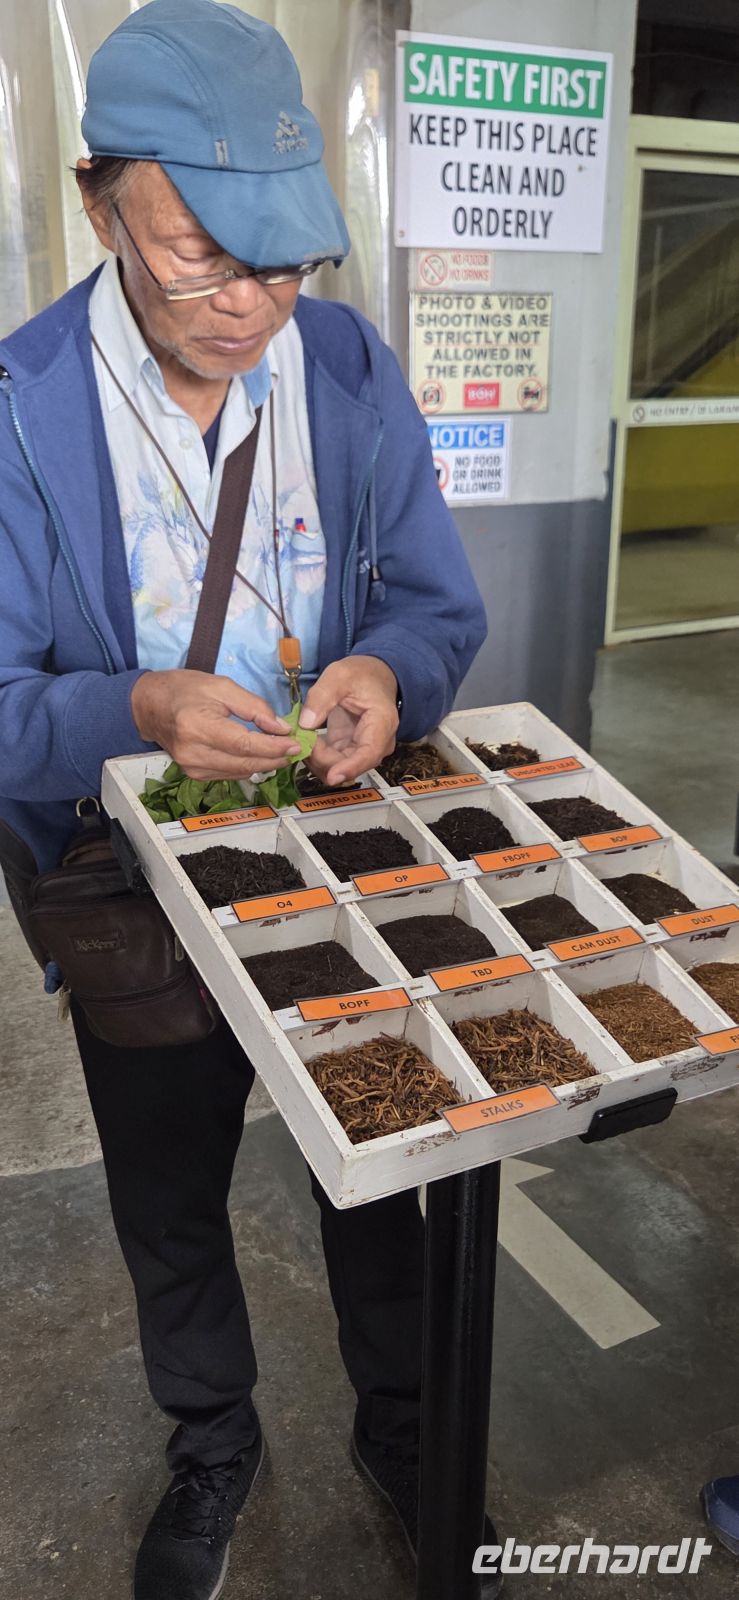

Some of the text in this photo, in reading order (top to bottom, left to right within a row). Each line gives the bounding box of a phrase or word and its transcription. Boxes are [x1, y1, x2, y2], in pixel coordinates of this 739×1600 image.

[408, 51, 604, 111] SAFETY FIRST
[408, 114, 598, 157] KEEP THIS PLACE
[440, 161, 565, 197] CLEAN AND
[452, 206, 553, 239] ORDERLY
[462, 270, 489, 281] DRINKS
[419, 297, 547, 310] PHOTO & VIDEO
[416, 314, 549, 328] SHOOTINGS ARE
[424, 331, 541, 345] STRICTLY NOT
[433, 348, 531, 361] ALLOWED IN
[425, 364, 537, 378] THE FACTORY.
[454, 456, 502, 468] NO FOOD
[452, 469, 502, 480] OR DRINK
[452, 481, 502, 494] ALLOWED
[513, 761, 576, 777] UNSORTED LEAF
[408, 776, 481, 792] FERMTED LEAF
[303, 792, 374, 808] WITHERED LEAF
[199, 811, 260, 826] GREEN LEAF
[610, 835, 628, 844] BOP
[502, 852, 532, 863] FBOPF
[394, 875, 409, 883] OP
[691, 915, 716, 925] DUST
[571, 935, 622, 952] CAM DUST
[471, 967, 493, 978] TBD
[338, 999, 371, 1010] BOPF
[480, 1099, 525, 1118] STALKS
